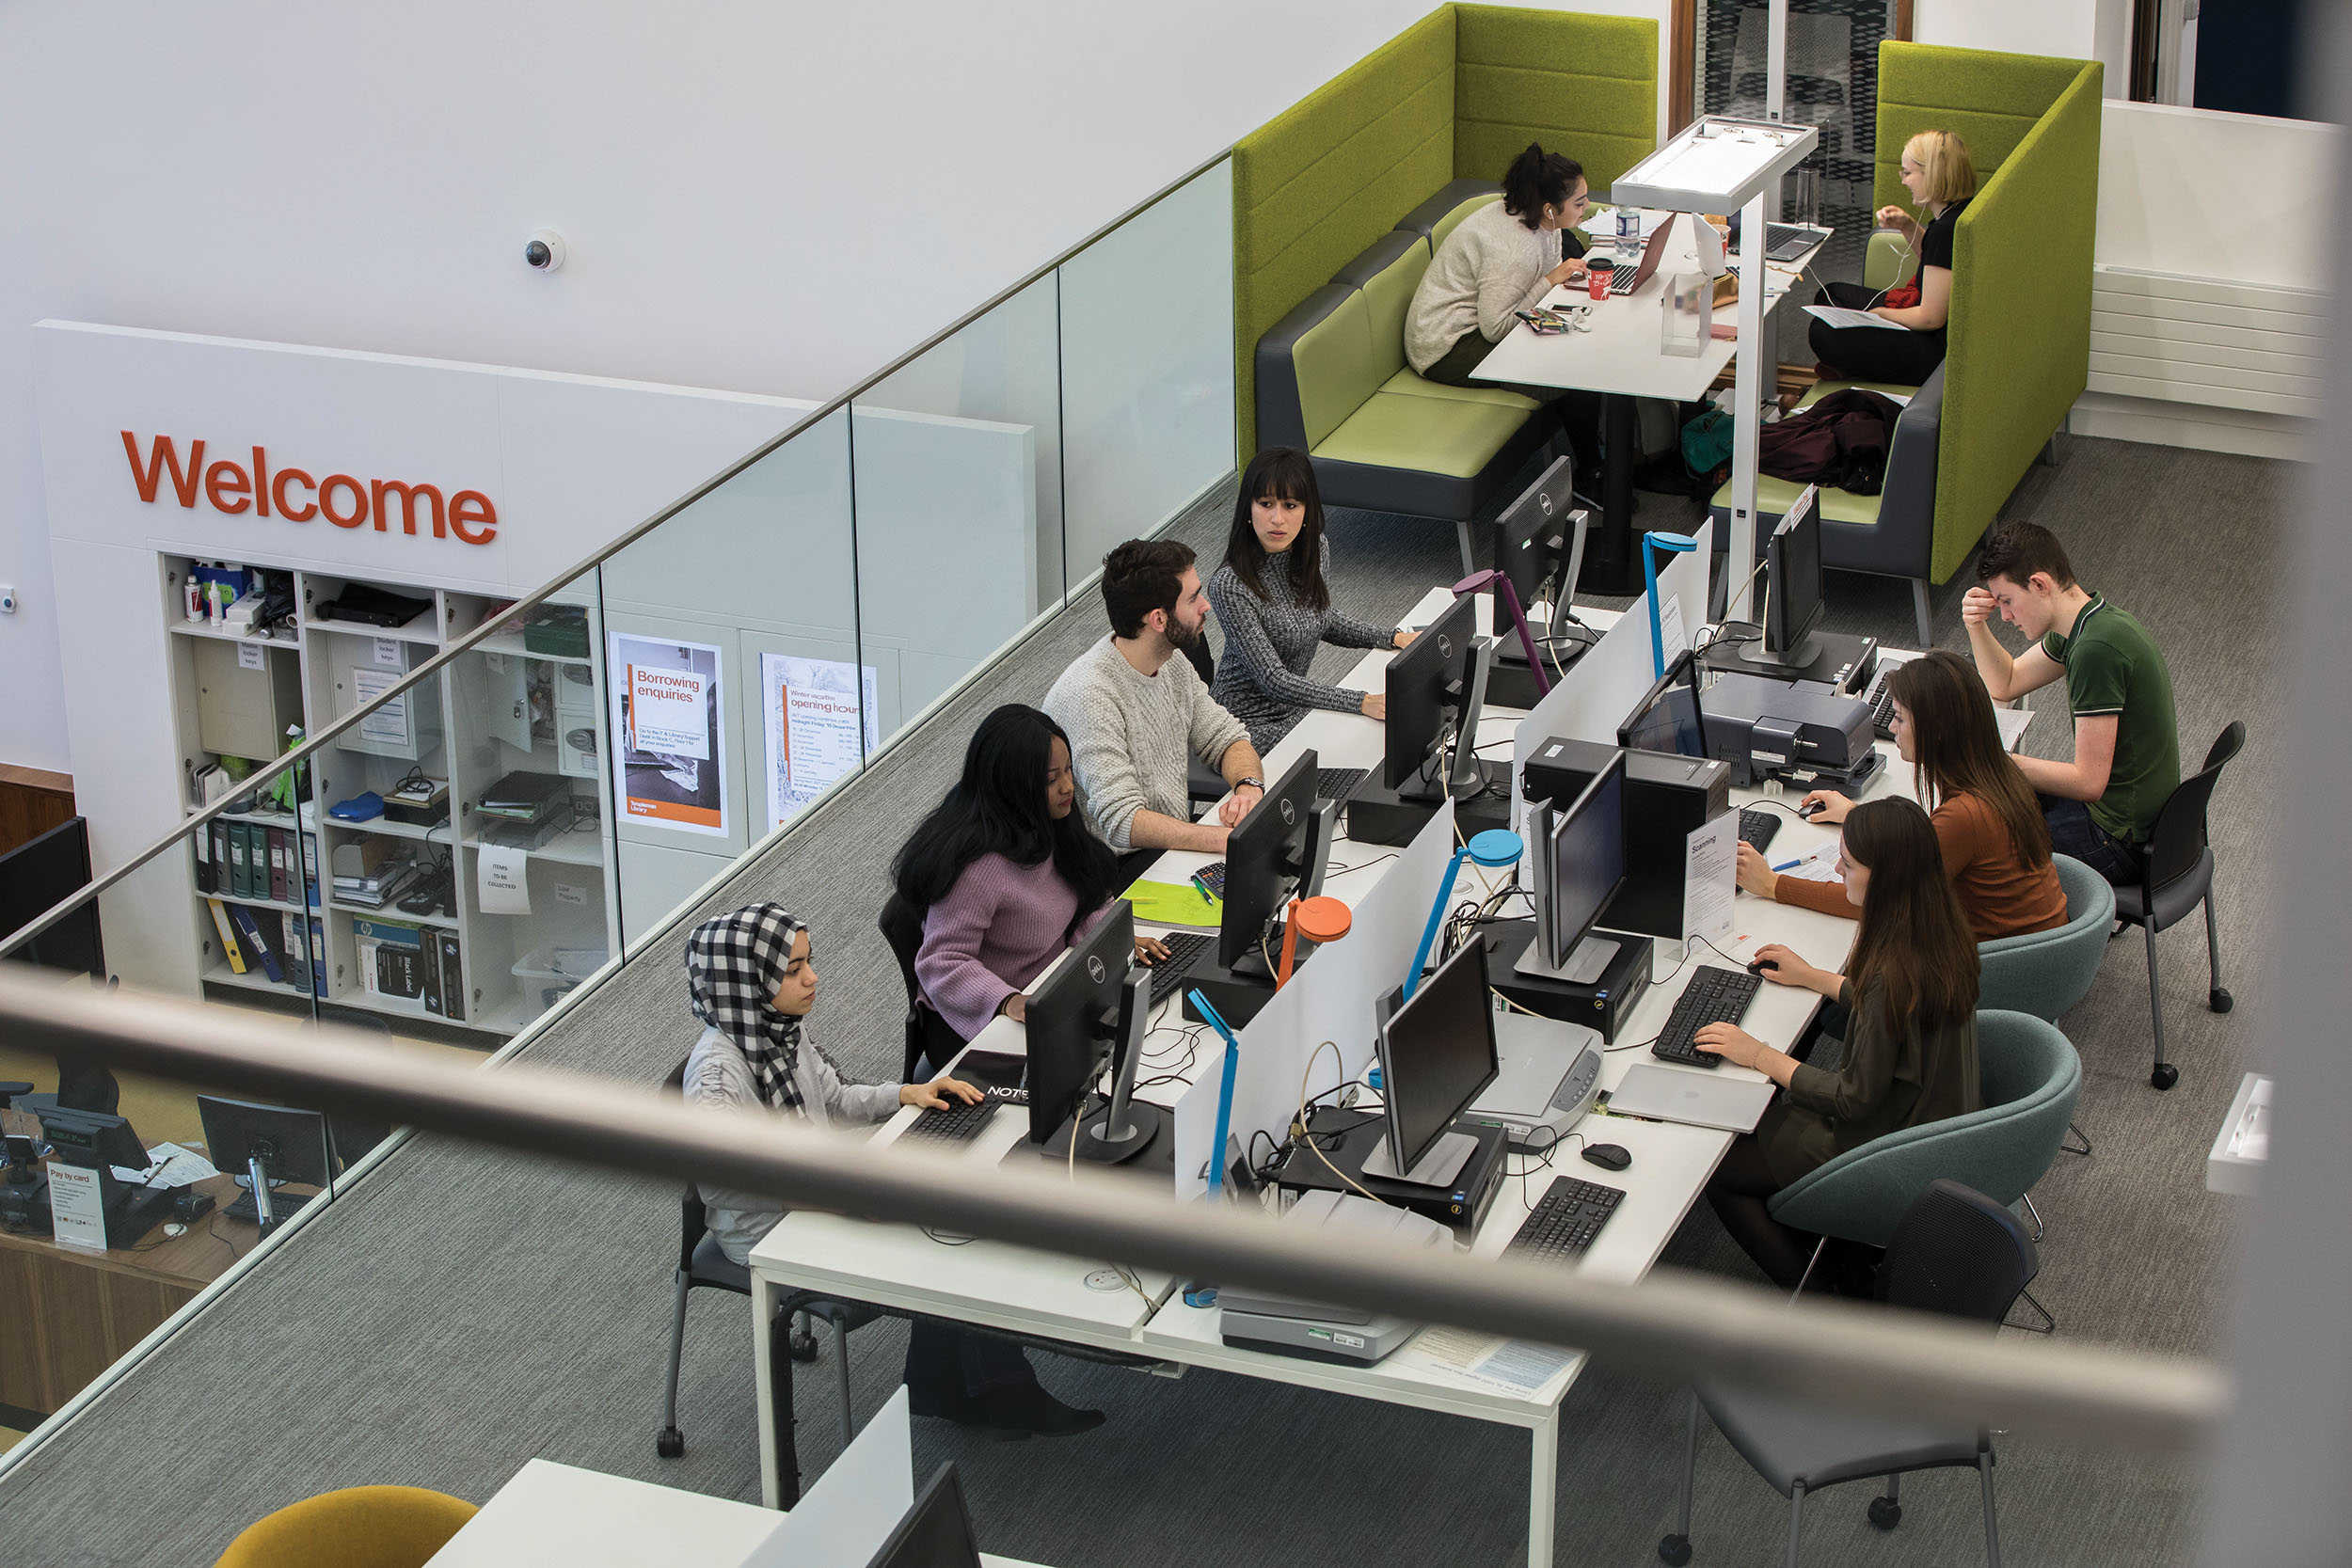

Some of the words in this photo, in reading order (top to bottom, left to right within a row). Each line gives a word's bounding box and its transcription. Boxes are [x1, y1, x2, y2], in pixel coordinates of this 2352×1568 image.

[120, 430, 498, 546] Welcome
[637, 670, 700, 693] Borrowing
[638, 686, 693, 703] enquiries
[790, 689, 810, 698] Winter
[791, 699, 832, 714] opening
[834, 702, 860, 714] hour
[51, 1169, 64, 1180] Pay
[64, 1172, 73, 1181] by
[73, 1175, 89, 1183] card
